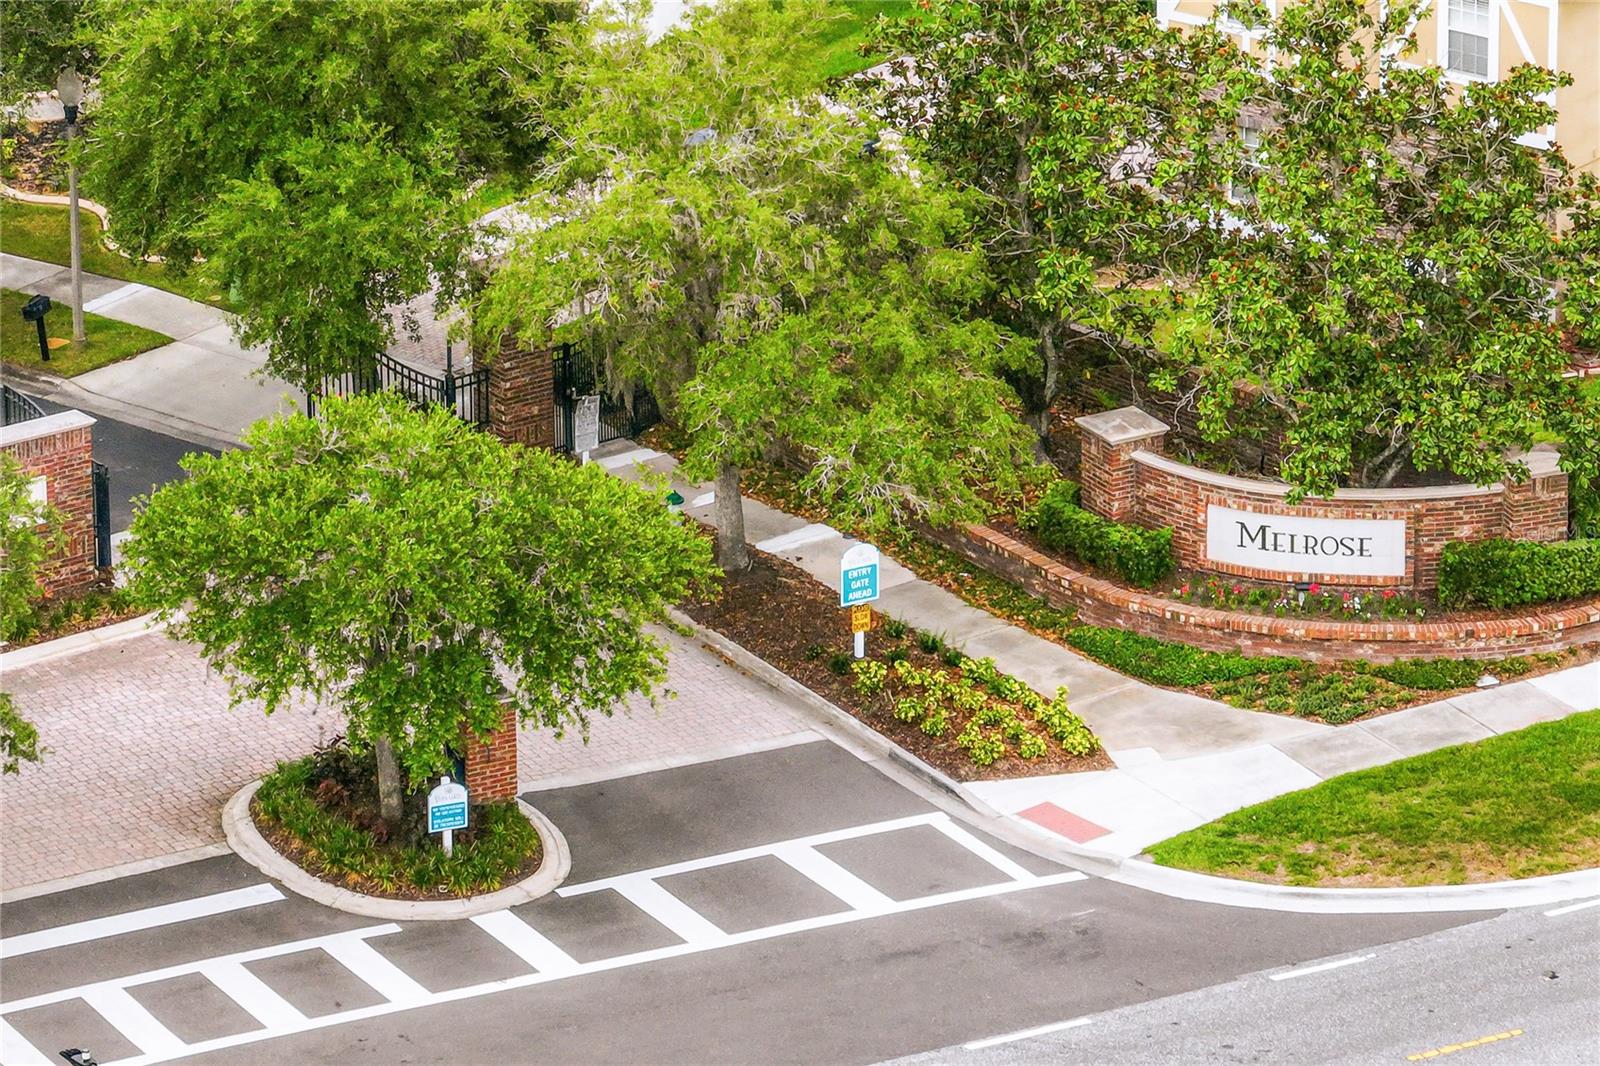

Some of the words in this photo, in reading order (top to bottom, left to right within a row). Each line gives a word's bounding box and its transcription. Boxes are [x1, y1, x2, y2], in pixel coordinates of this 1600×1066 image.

[1235, 521, 1373, 558] MELROSE
[848, 567, 872, 579] ENTRY
[850, 578, 870, 589] GATE
[848, 588, 873, 601] AHEAD
